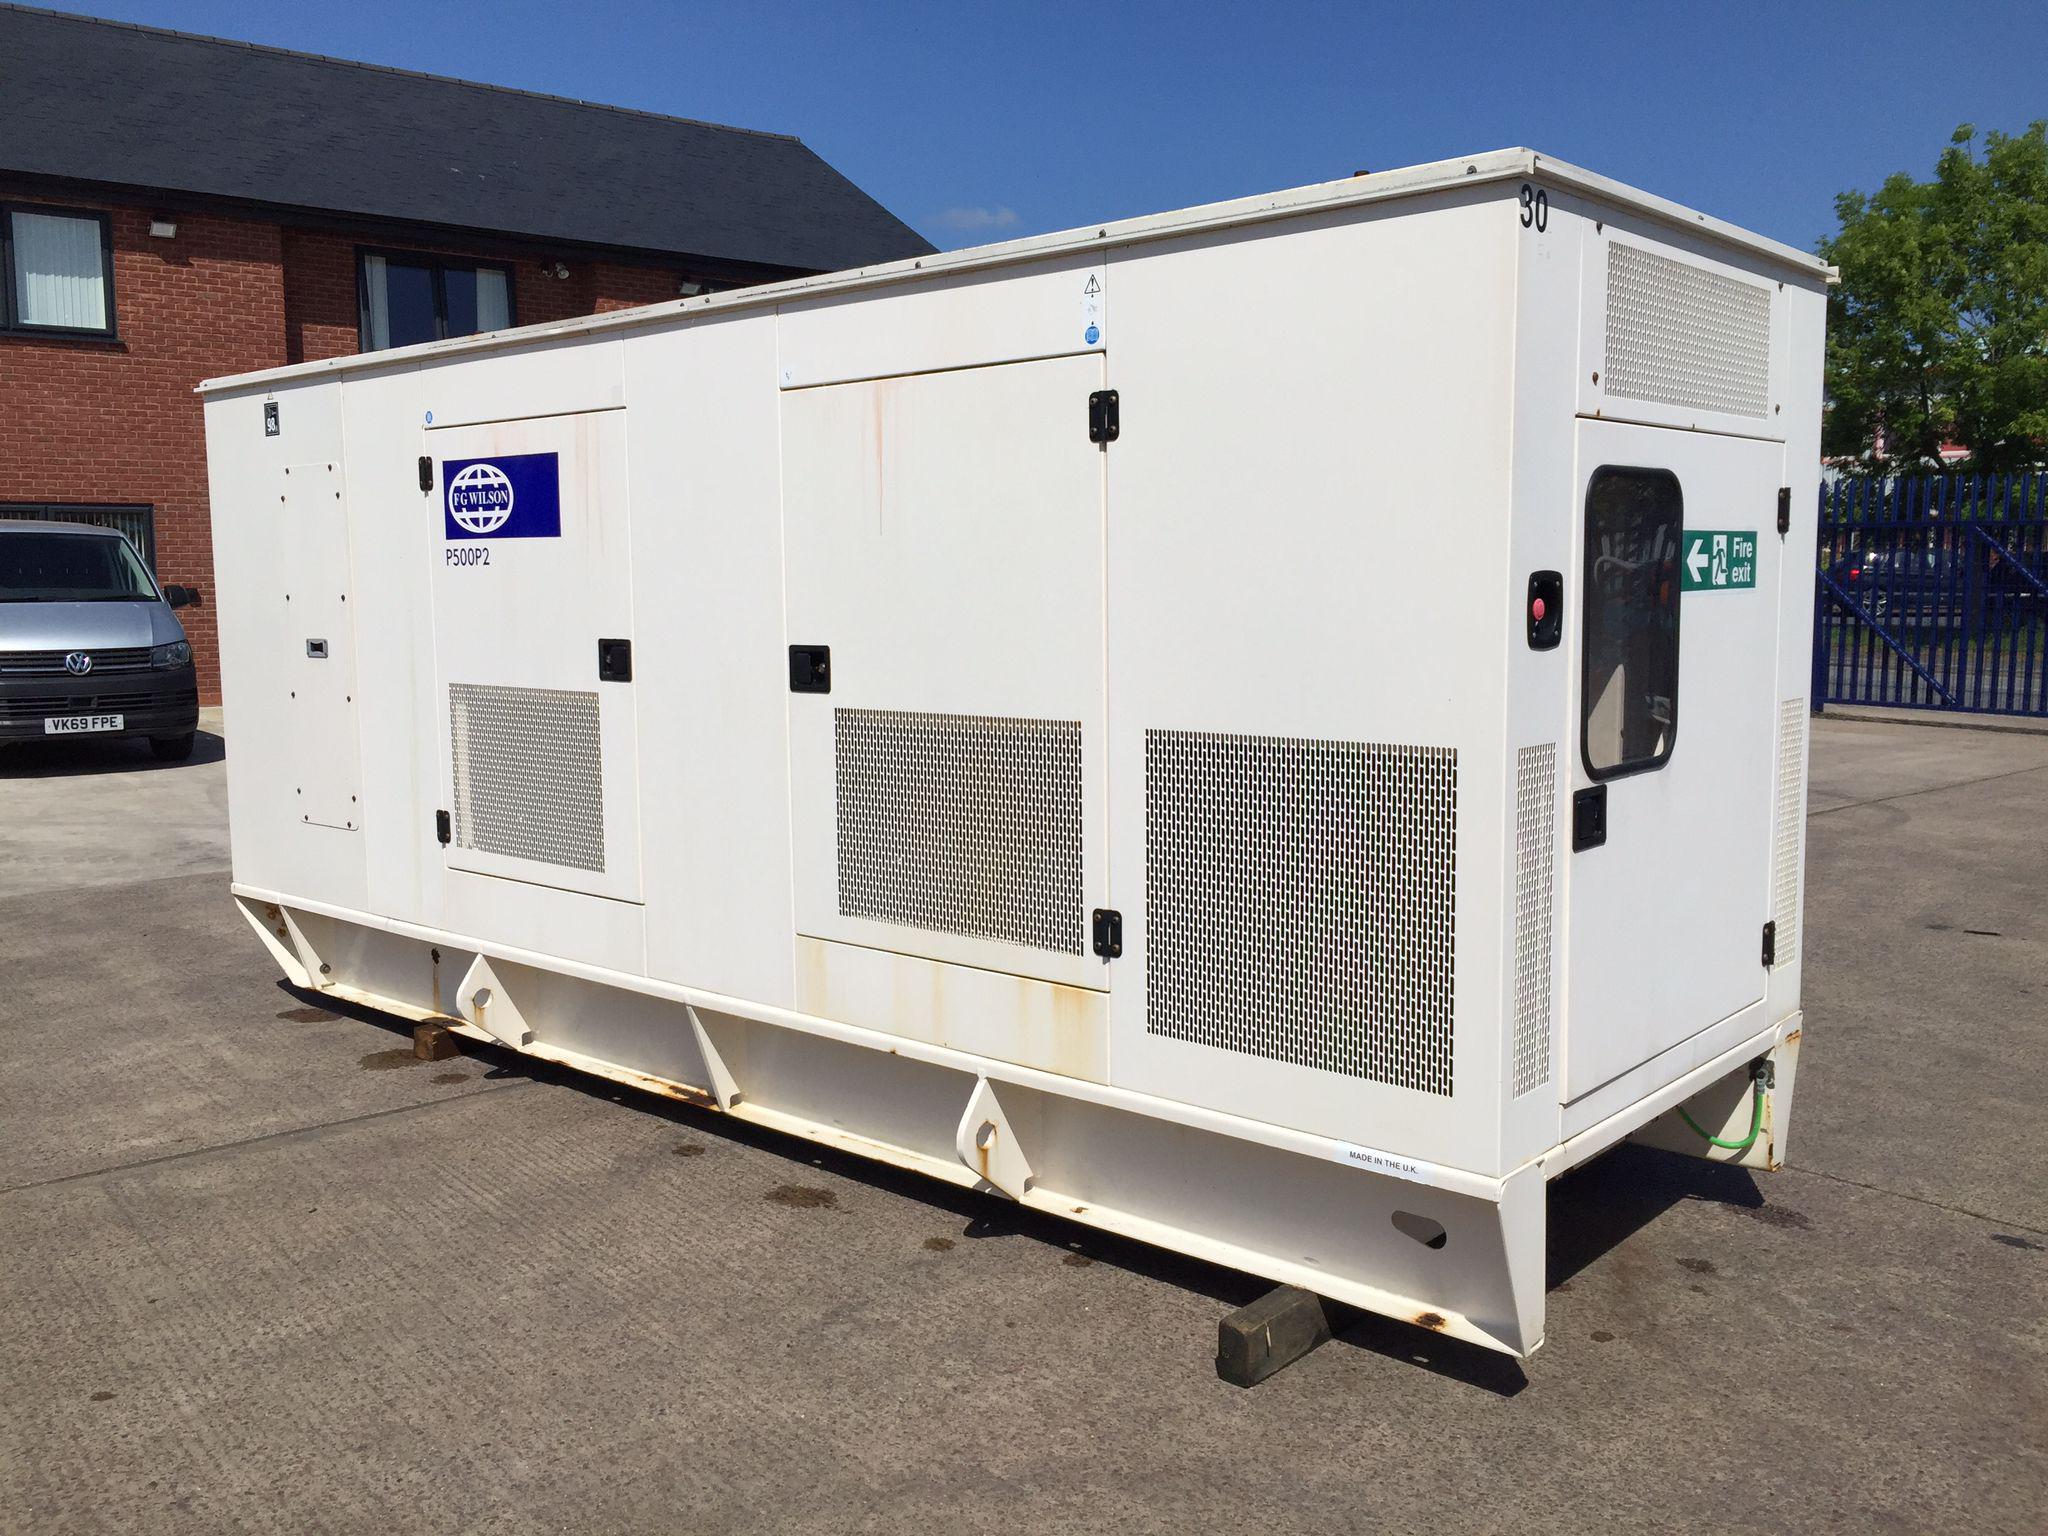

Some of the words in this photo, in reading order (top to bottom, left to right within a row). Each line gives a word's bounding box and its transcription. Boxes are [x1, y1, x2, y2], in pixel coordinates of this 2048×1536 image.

[1520, 183, 1547, 233] 30
[453, 492, 468, 506] FG
[469, 490, 508, 505] WILSON
[446, 547, 490, 566] P500P2
[1733, 537, 1753, 558] Fire
[1732, 562, 1751, 582] exit
[52, 718, 88, 731] VK69
[91, 716, 118, 729] FPE
[1349, 1151, 1372, 1163] MADE
[1374, 1156, 1383, 1165] IN
[1385, 1159, 1401, 1169] THE
